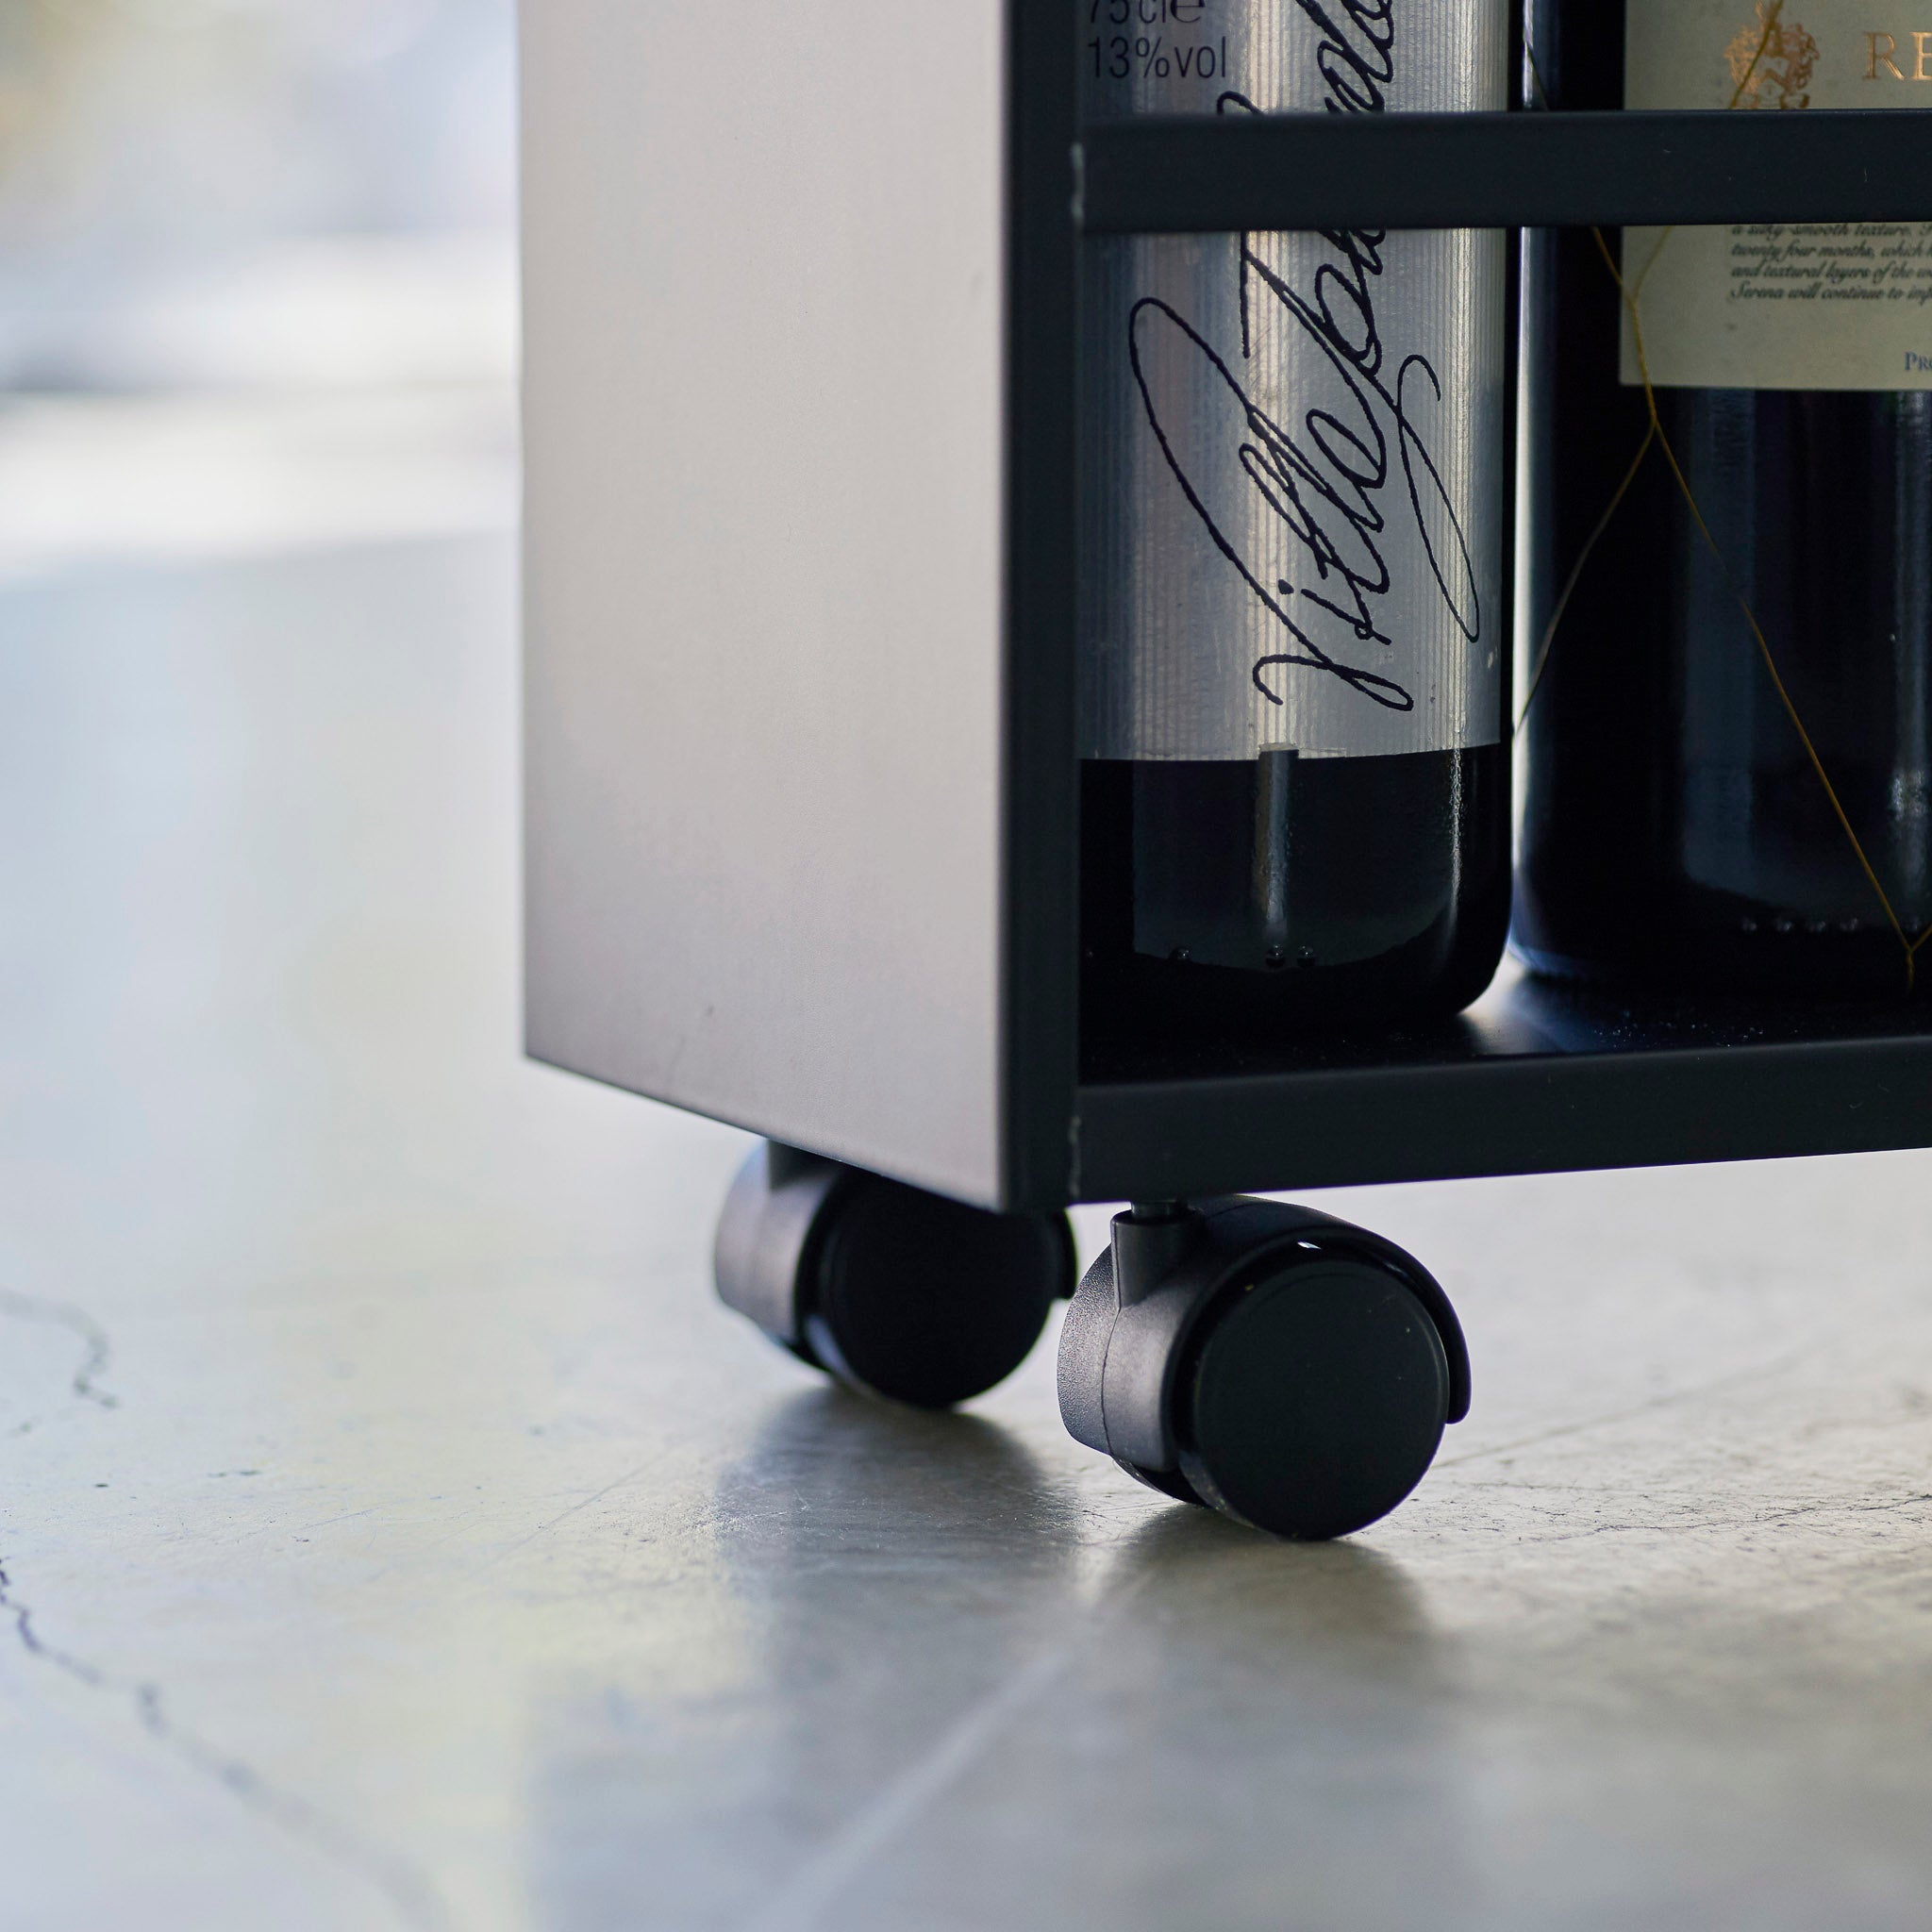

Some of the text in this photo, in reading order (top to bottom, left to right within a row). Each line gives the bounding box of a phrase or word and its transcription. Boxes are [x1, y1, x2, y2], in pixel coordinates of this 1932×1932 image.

[1872, 260, 1896, 283] of
[1890, 260, 1915, 277] the
[1821, 285, 1885, 299] continue
[1888, 287, 1905, 299] to
